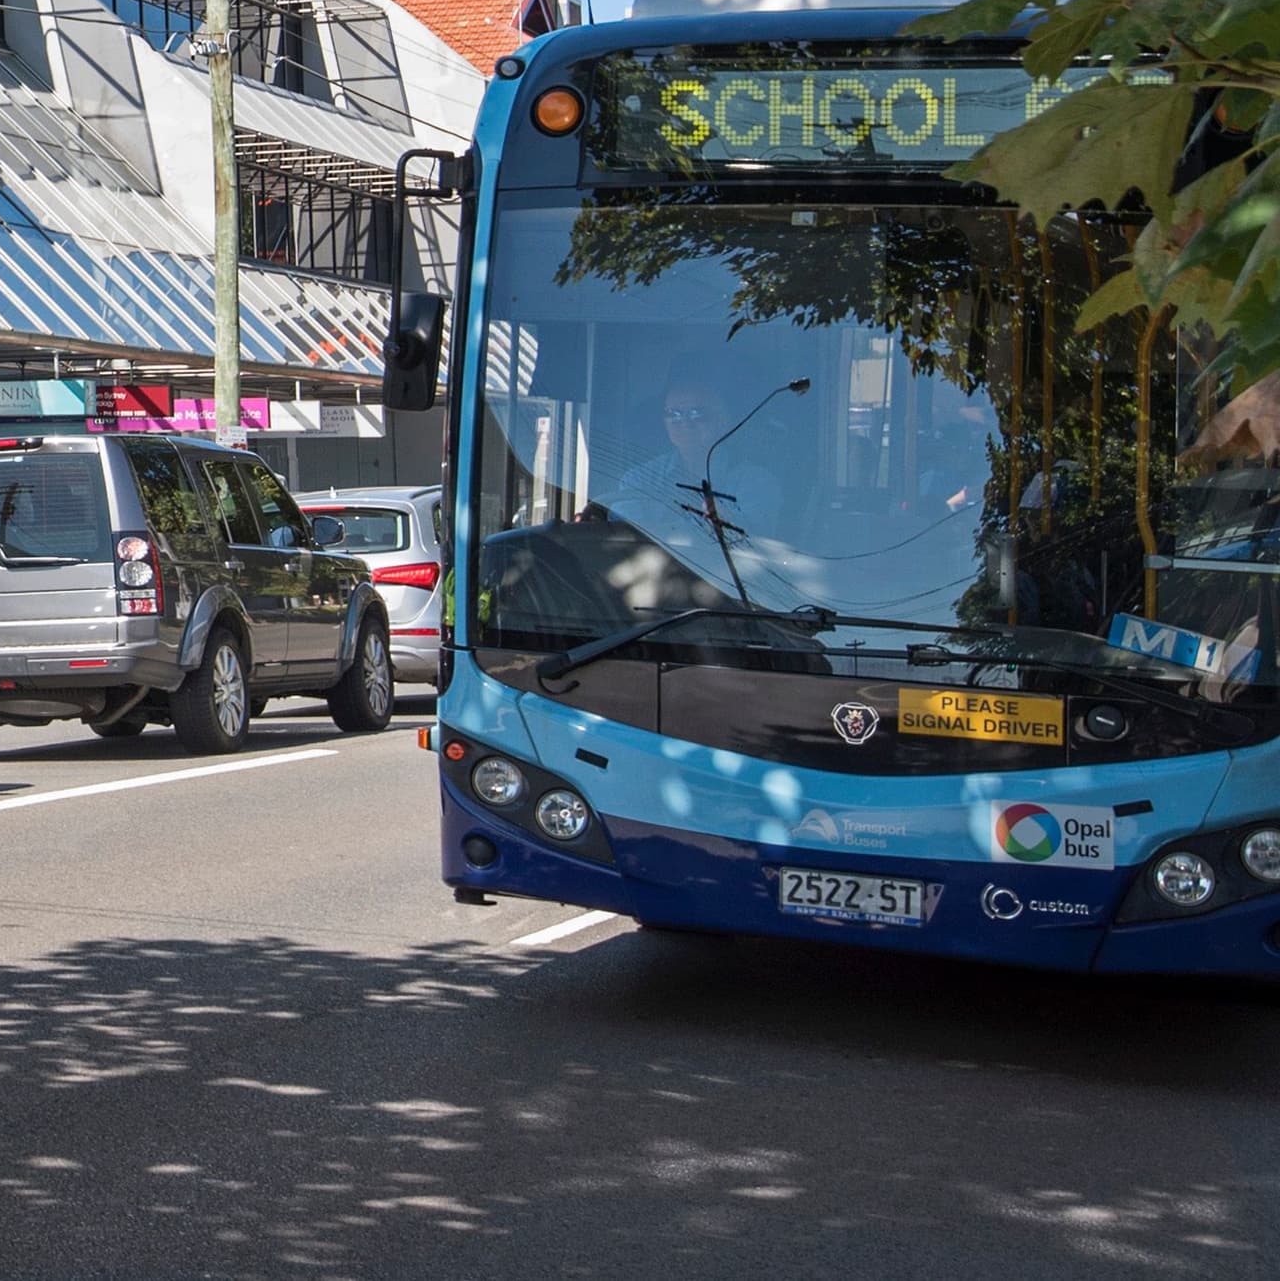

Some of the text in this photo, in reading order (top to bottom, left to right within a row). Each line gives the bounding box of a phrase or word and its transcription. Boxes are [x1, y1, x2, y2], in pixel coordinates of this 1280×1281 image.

[661, 77, 985, 146] SCHOOL
[185, 410, 216, 420] Medica
[941, 697, 1019, 715] PLEASE
[903, 713, 1059, 738] SIGNAL DRIVER
[842, 818, 907, 836] Transport
[1064, 818, 1111, 842] Opal
[844, 834, 887, 848] Buses
[1065, 839, 1100, 858] bus
[1029, 899, 1089, 915] custom
